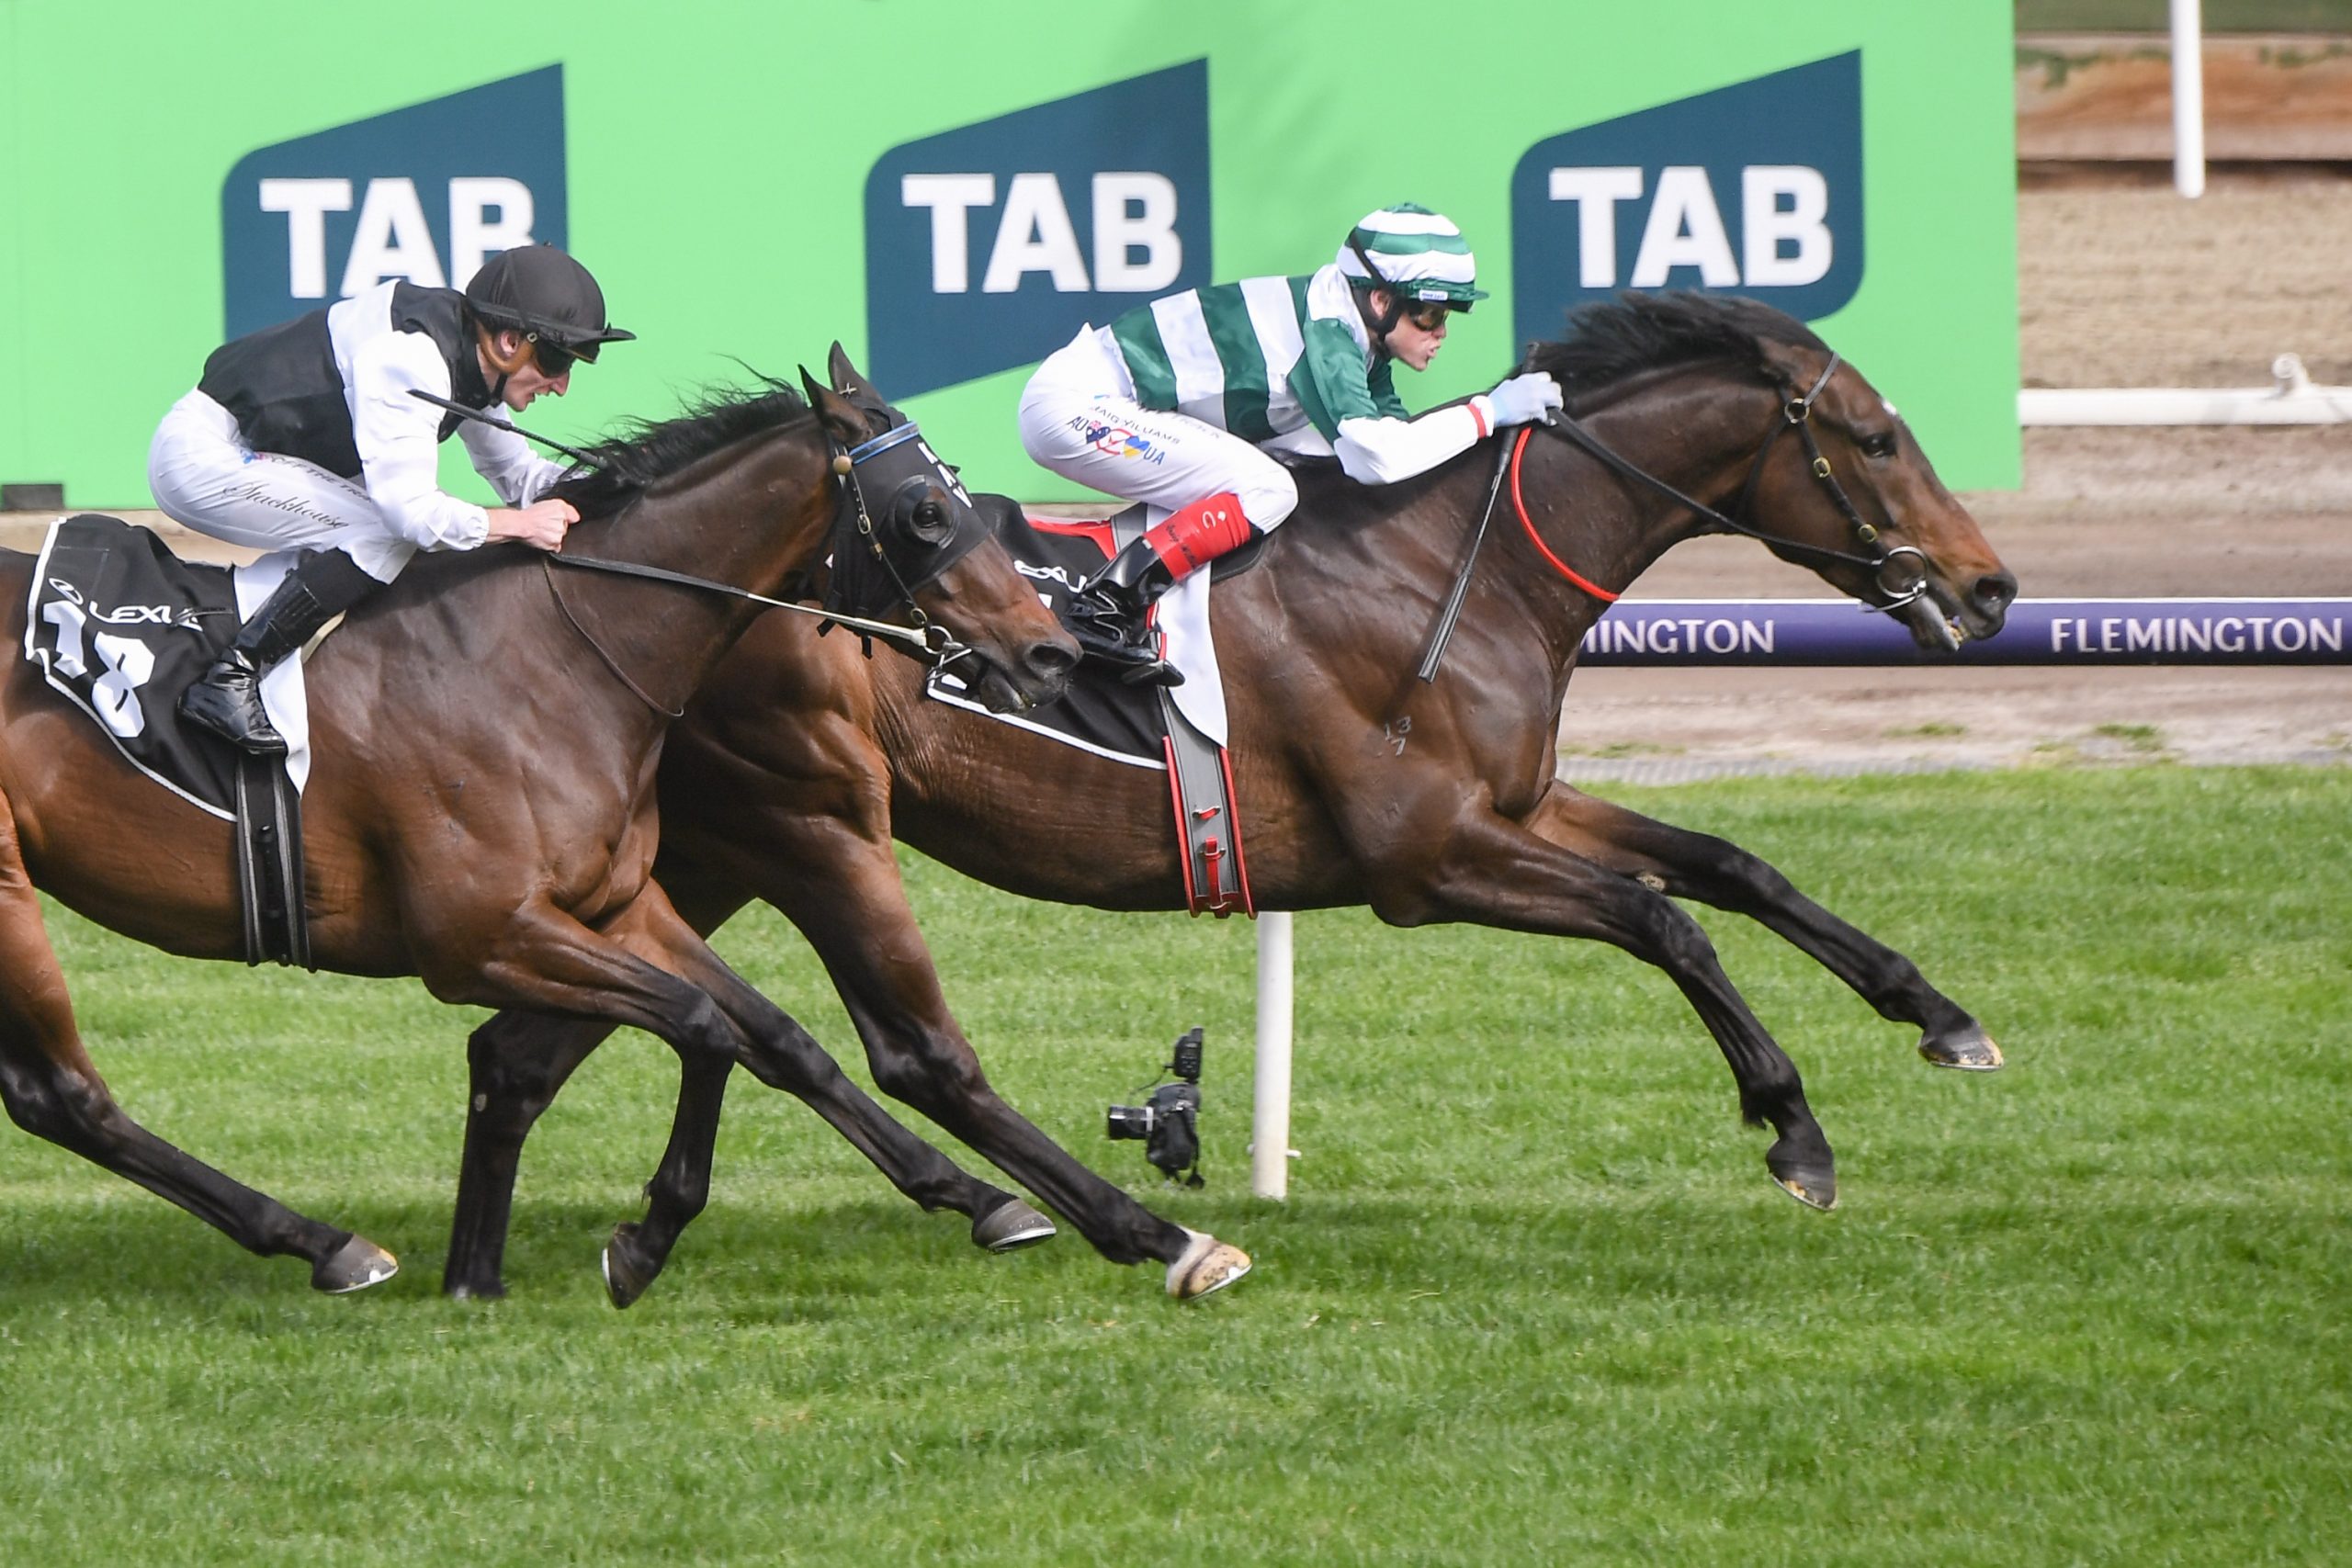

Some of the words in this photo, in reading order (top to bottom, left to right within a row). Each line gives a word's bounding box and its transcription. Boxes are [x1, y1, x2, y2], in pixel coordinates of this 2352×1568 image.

[901, 172, 1182, 294] TAB
[1549, 164, 1834, 288] TAB
[1067, 415, 1089, 432] AU
[1143, 447, 1166, 466] UA
[43, 600, 155, 739] 18
[2050, 617, 2343, 652] FLEMINGTON
